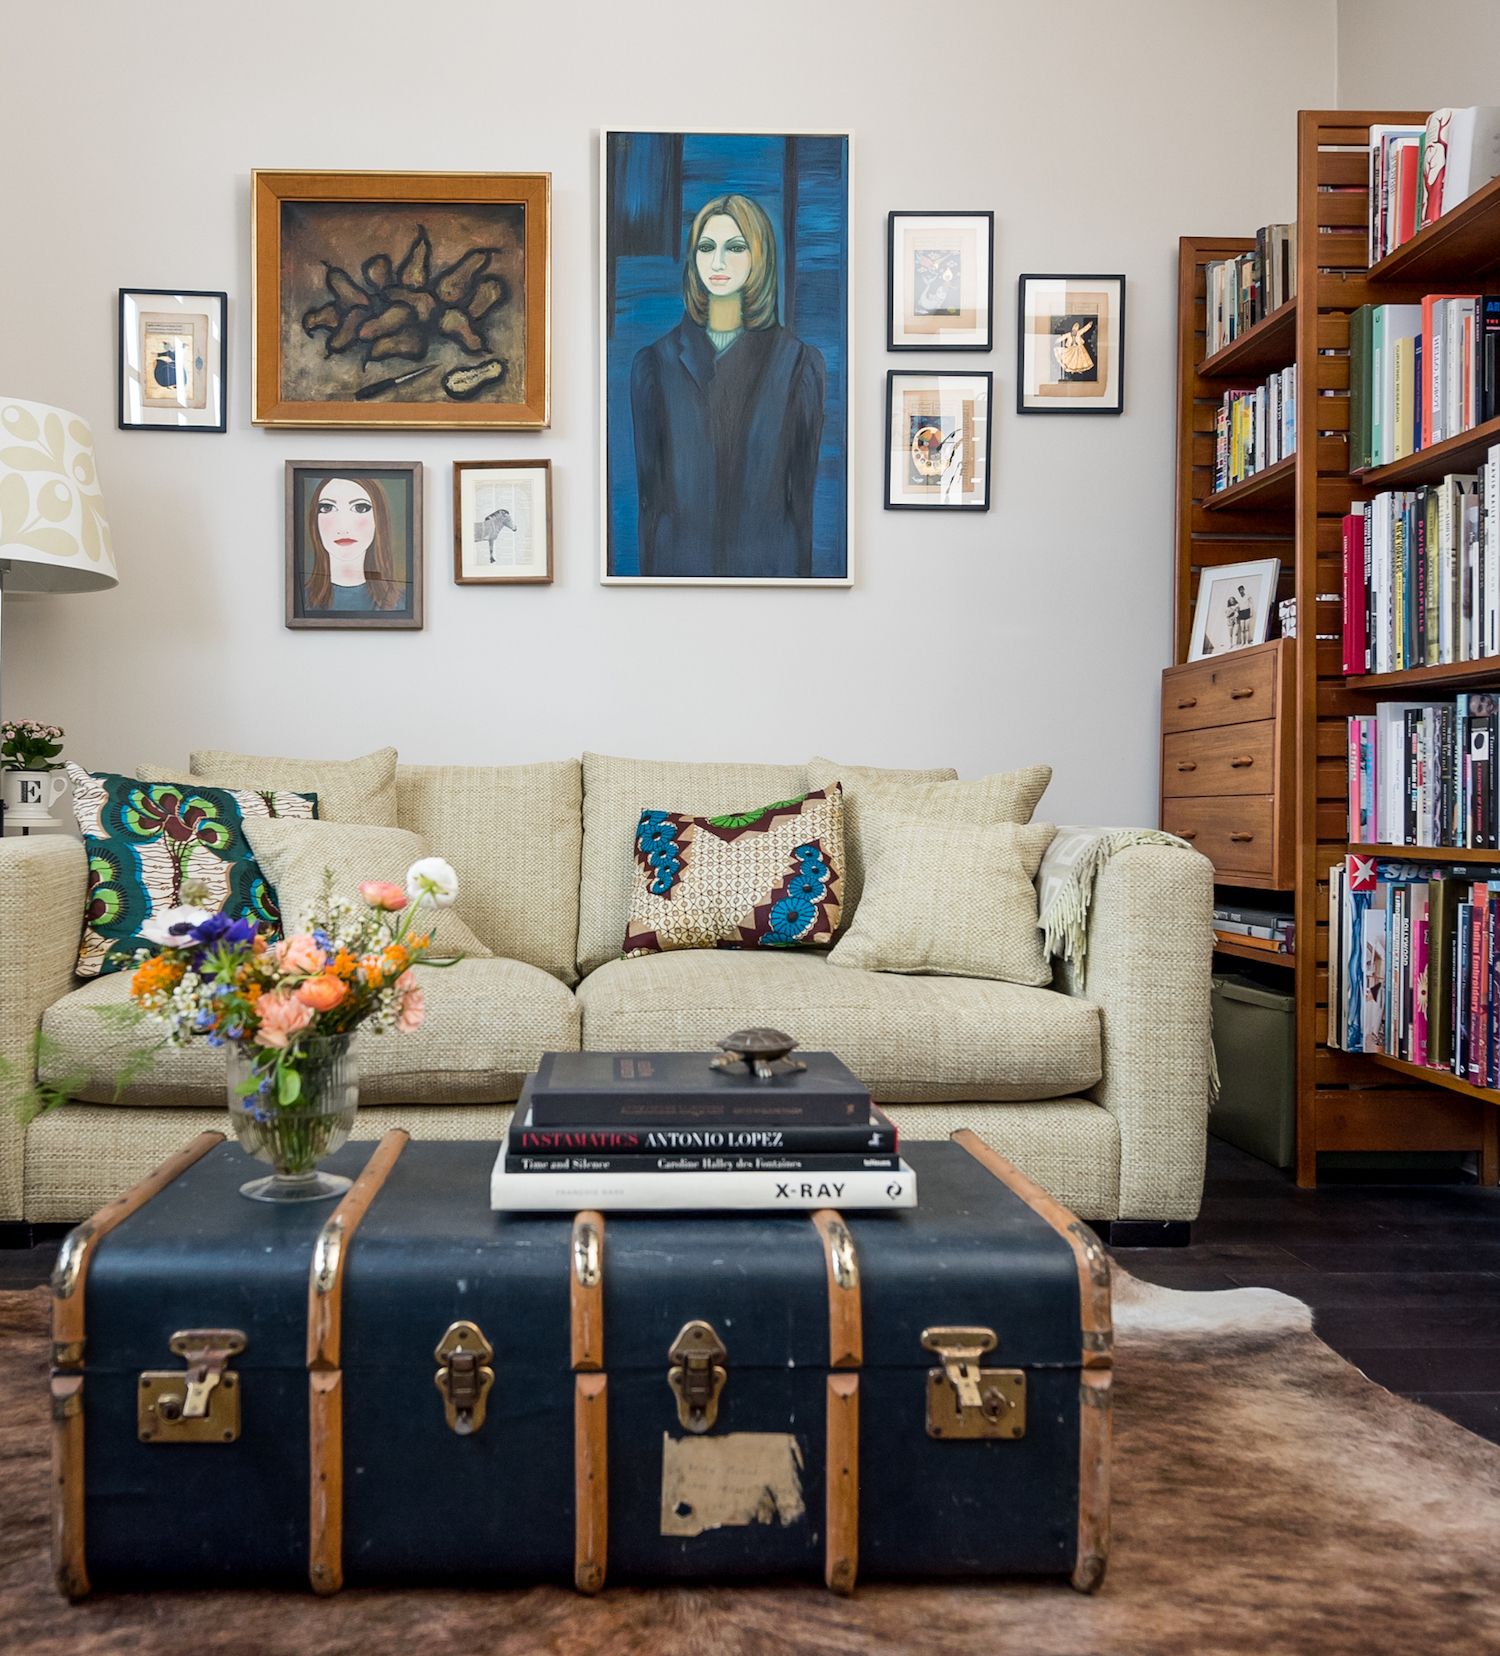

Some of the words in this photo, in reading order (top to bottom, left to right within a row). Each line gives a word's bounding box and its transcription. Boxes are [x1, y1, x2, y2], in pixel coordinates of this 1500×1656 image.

[17, 780, 41, 803] E
[1473, 921, 1481, 954] Indian
[1471, 954, 1481, 1013] Embroidery
[522, 1132, 640, 1148] INSTAMATICS
[644, 1132, 724, 1147] ANTONIO
[728, 1131, 784, 1147] LOPEZ
[522, 1158, 548, 1170] Time
[550, 1158, 570, 1170] and
[572, 1158, 611, 1170] Silence
[657, 1158, 699, 1170] Caroline
[702, 1157, 733, 1172] Halley
[735, 1157, 753, 1169] des
[755, 1157, 803, 1169] Fontaines
[776, 1183, 845, 1198] X-RAY
